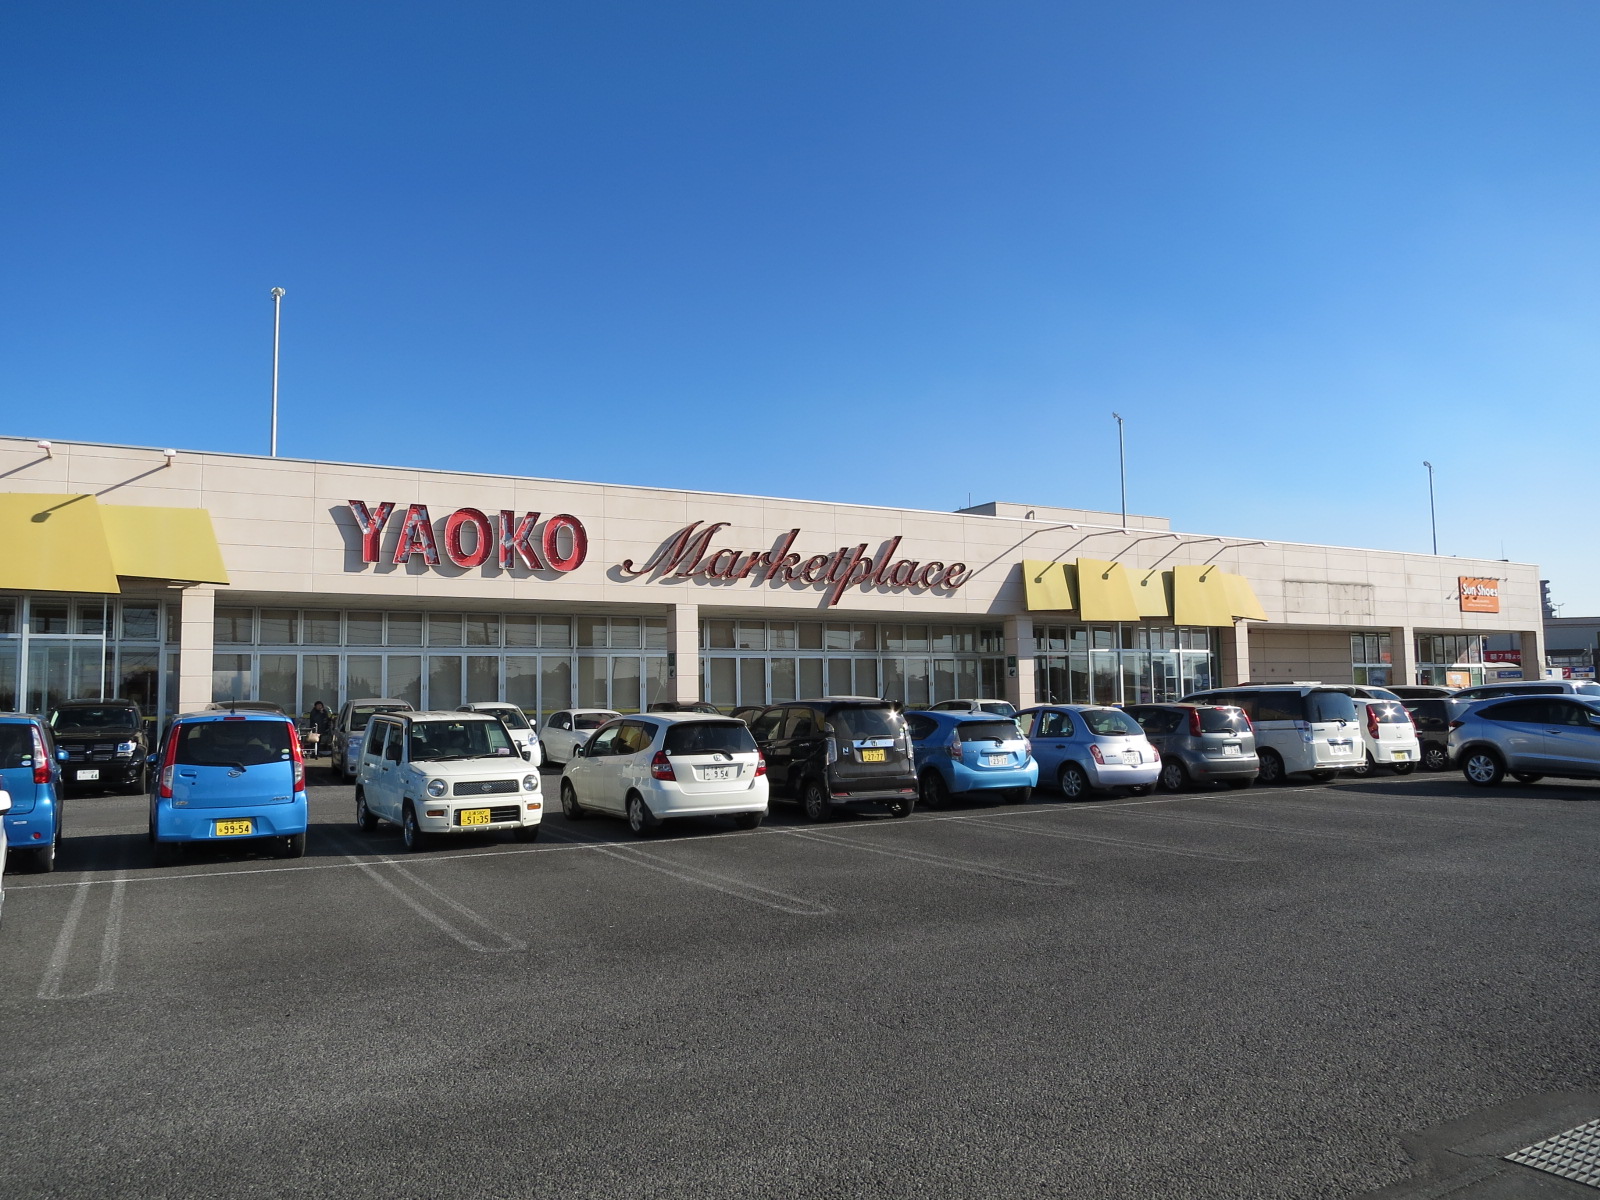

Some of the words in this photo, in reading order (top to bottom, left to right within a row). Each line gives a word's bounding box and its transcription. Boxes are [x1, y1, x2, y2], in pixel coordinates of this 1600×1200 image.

[348, 500, 588, 572] YAOKO
[622, 520, 973, 606] Marketplace
[1462, 583, 1477, 596] Sun
[1477, 584, 1498, 597] Shoes
[467, 815, 489, 824] 51-35
[224, 824, 250, 834] 99-54
